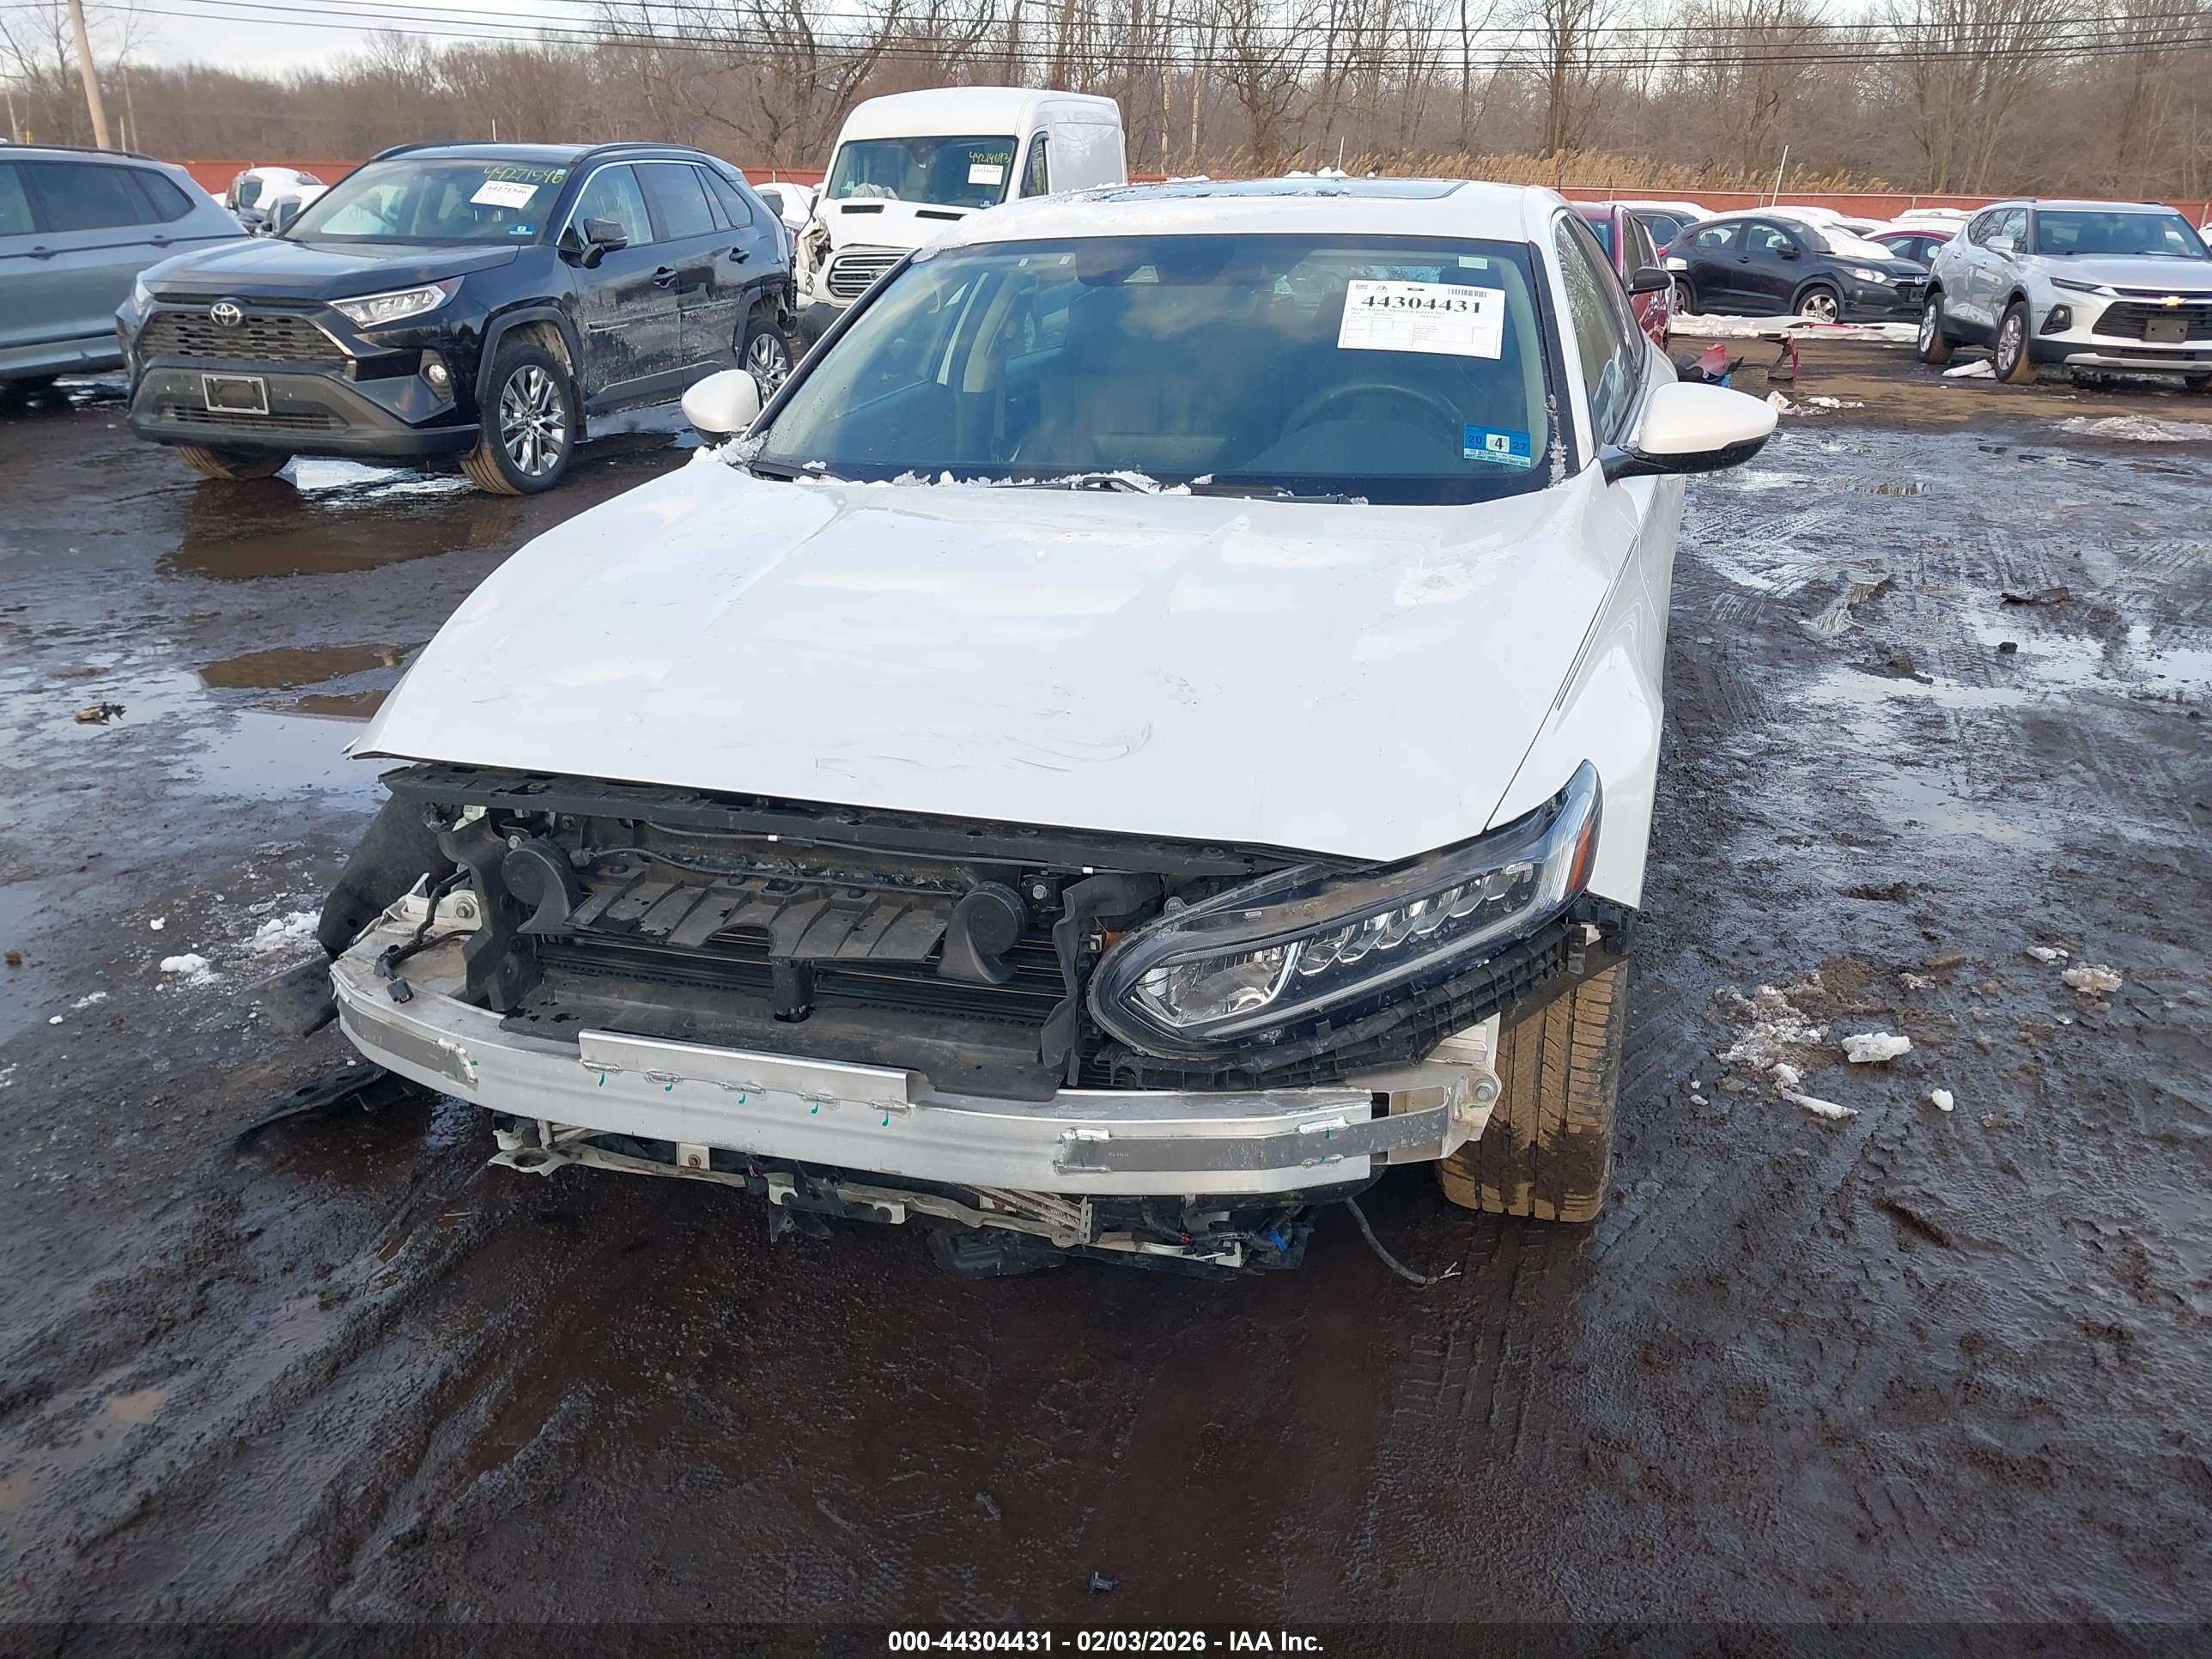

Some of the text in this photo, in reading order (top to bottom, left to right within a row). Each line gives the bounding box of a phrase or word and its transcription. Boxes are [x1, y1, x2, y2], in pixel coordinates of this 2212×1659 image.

[483, 165, 564, 184] 44271546
[1361, 295, 1482, 314] 44304431
[1468, 435, 1527, 451] 20 4 27
